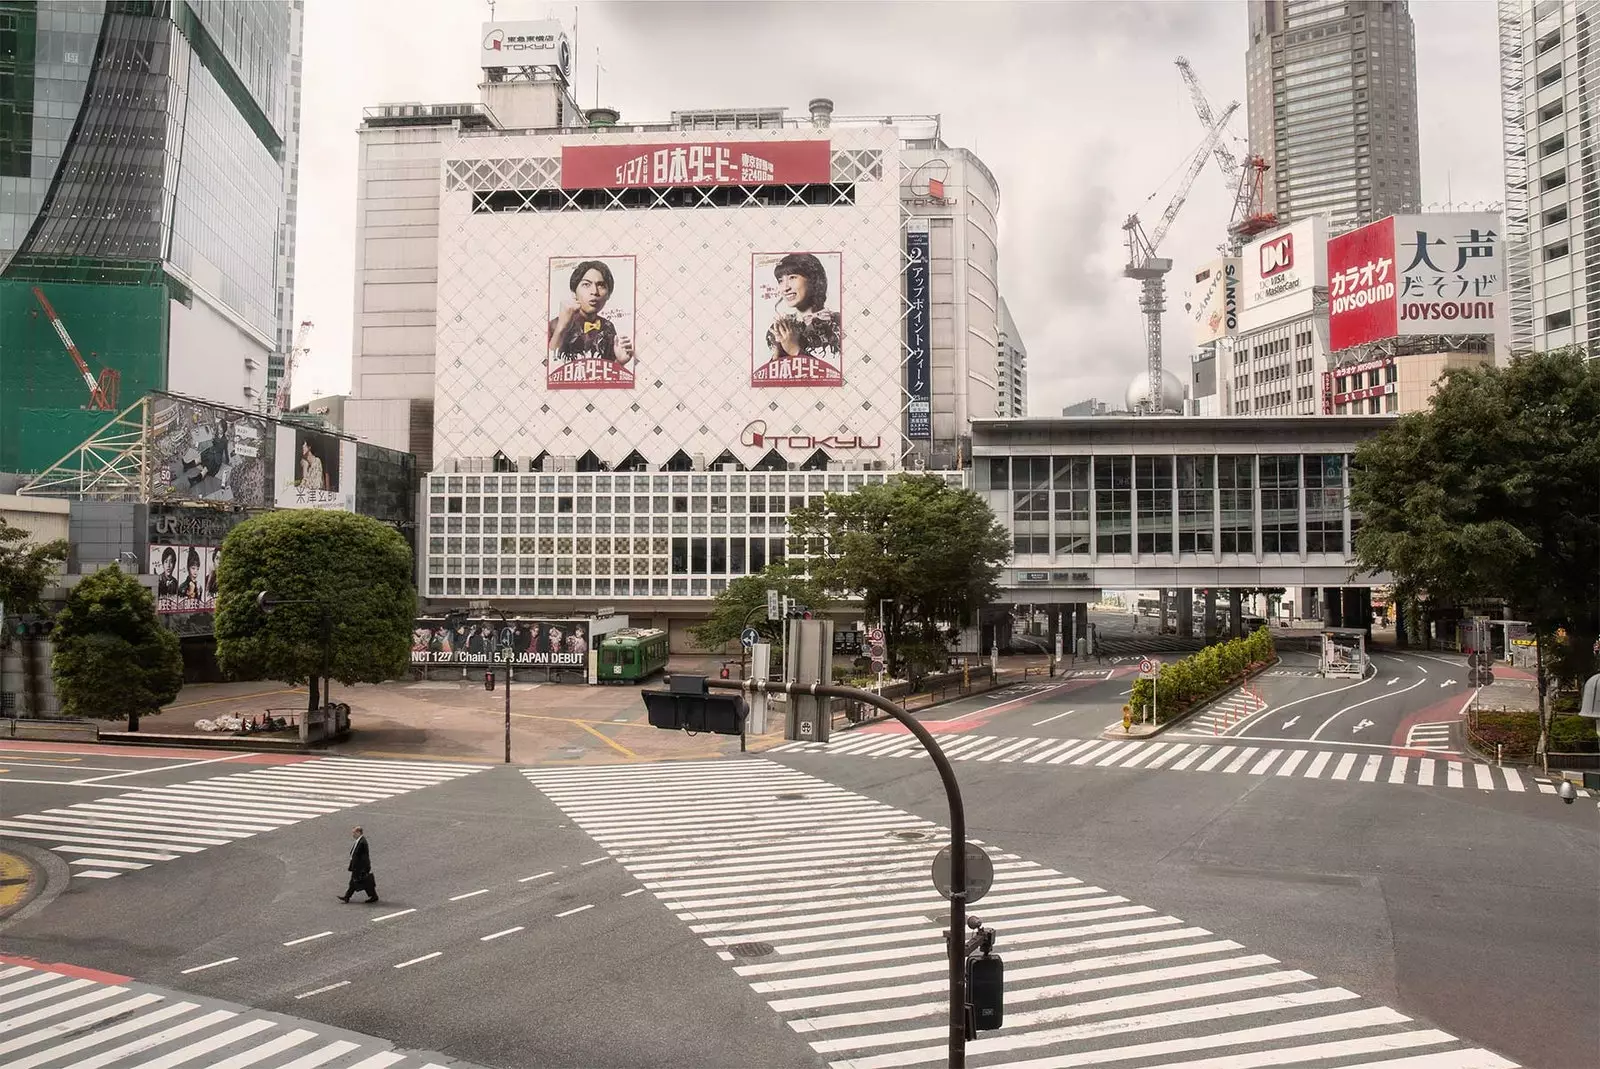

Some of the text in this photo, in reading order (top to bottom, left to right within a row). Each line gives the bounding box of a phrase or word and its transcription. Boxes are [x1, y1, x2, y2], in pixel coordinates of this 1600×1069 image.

[615, 156, 643, 184] 5/27
[653, 146, 738, 184] 日本ダービー
[902, 198, 957, 206] TOKYU
[1261, 239, 1290, 273] DC
[1400, 229, 1497, 273] 大声
[1265, 277, 1300, 297] MasterCard
[1270, 273, 1285, 286] VISA
[1331, 257, 1392, 297] カラオケ
[1400, 274, 1498, 299] だそうぜ
[1225, 264, 1240, 329] SANKYO
[1331, 282, 1395, 315] JOYSOUND
[912, 267, 925, 392] アップポイントウィーク
[563, 360, 618, 381] 日本ダービー
[769, 358, 825, 379] 日本ダービー
[764, 436, 881, 449] TOKYU
[411, 652, 431, 662] NCT
[516, 653, 548, 663] JAPAN
[550, 653, 583, 664] DEBUT
